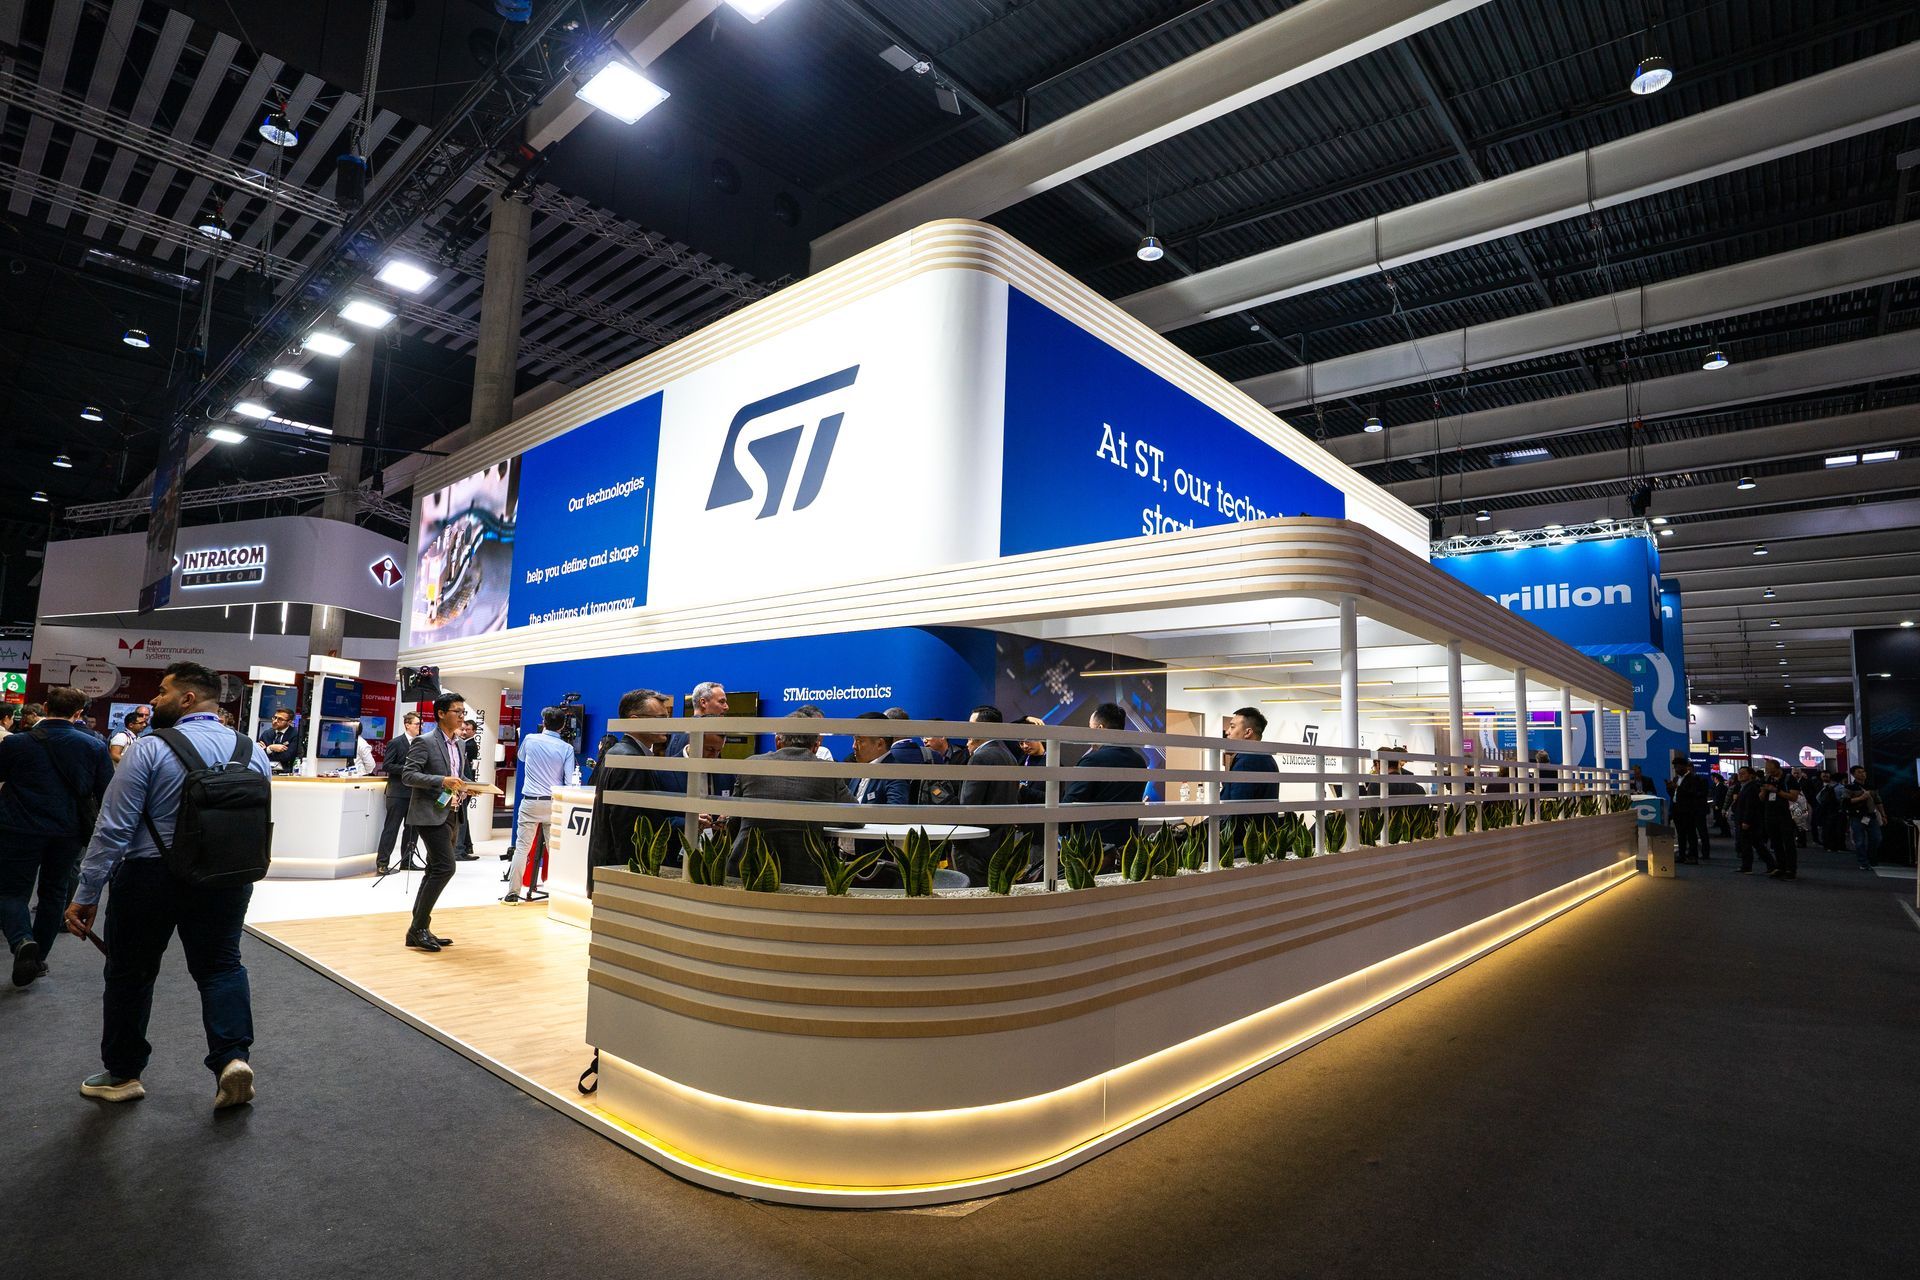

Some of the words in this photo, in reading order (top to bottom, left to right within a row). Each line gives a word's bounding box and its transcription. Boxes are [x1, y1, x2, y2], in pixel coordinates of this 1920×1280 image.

[1096, 422, 1128, 469] At
[1135, 439, 1168, 492] ST,
[1174, 468, 1211, 507] our
[568, 497, 584, 512] Our
[585, 476, 645, 507] technologies
[183, 546, 265, 570] INTRACOM
[526, 568, 543, 584] help
[544, 565, 560, 582] you
[561, 557, 587, 575] define
[589, 549, 608, 568] and
[609, 544, 639, 563] shape
[186, 573, 258, 585] TELECOM
[529, 612, 541, 625] the
[543, 606, 578, 623] solutions
[580, 602, 589, 617] of
[590, 596, 636, 614] tomorrow
[146, 646, 204, 655] telecommunication
[147, 638, 162, 646] faini
[783, 684, 892, 702] STMicroelectronics
